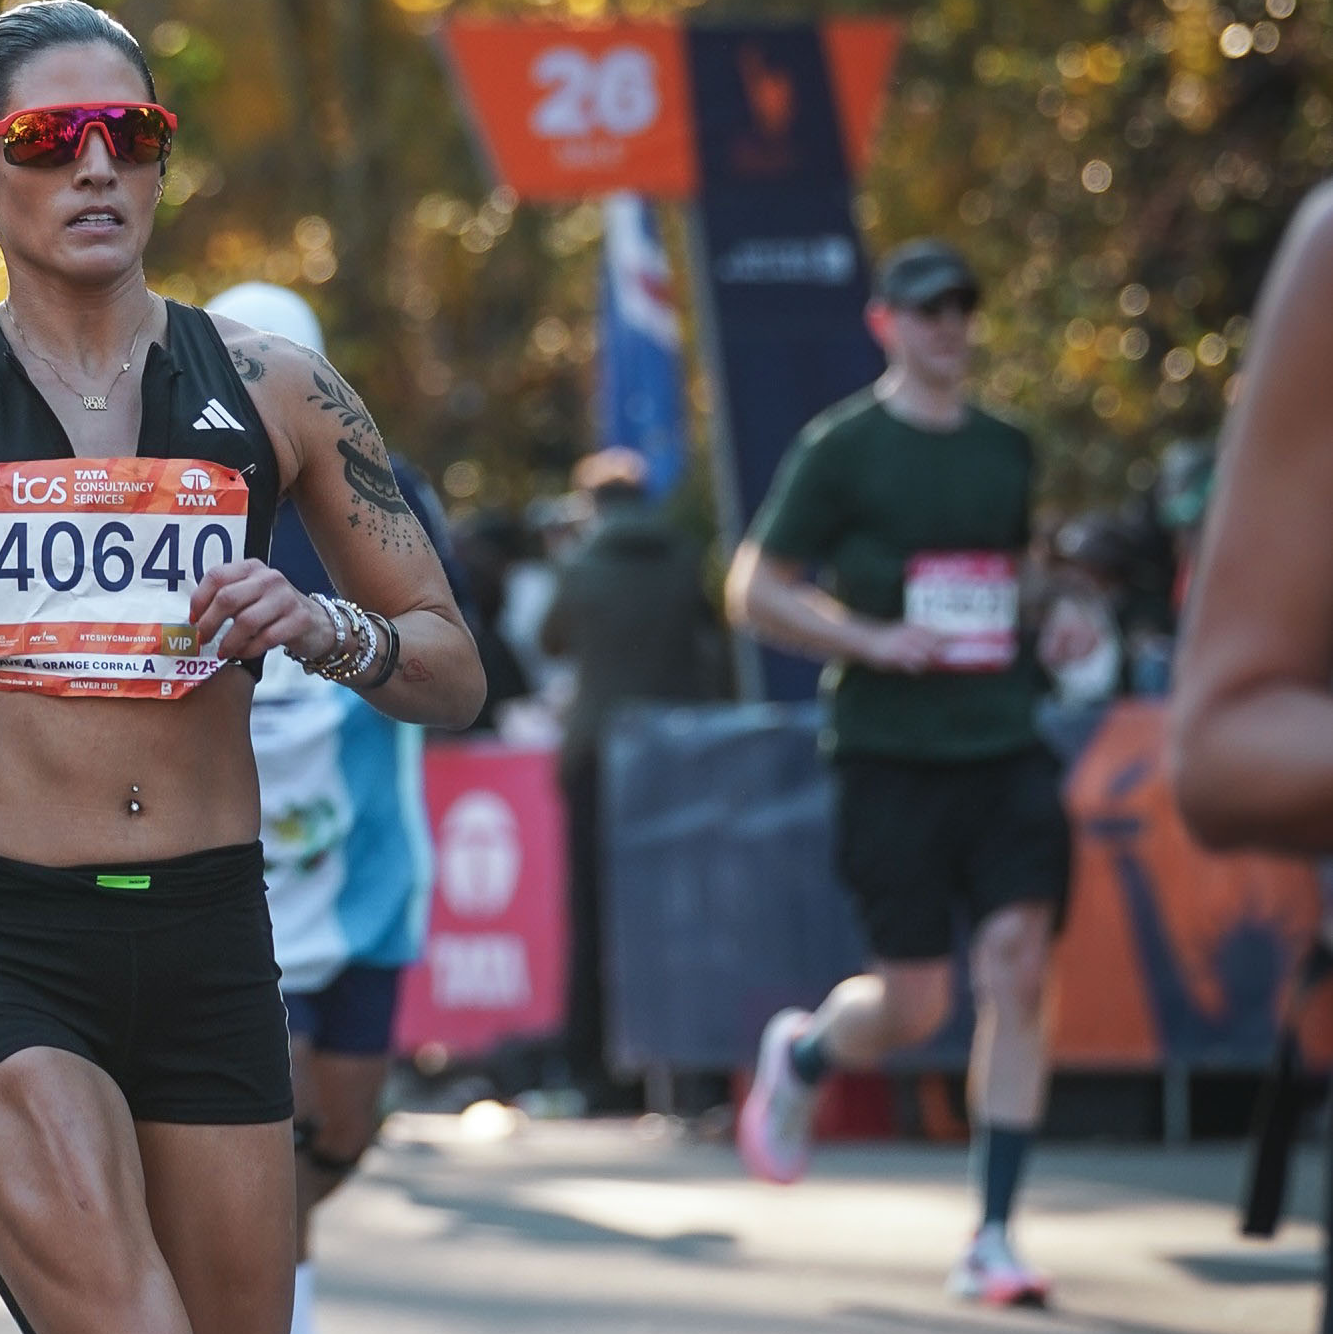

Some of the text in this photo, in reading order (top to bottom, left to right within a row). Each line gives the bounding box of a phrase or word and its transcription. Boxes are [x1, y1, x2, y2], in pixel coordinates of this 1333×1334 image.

[529, 43, 659, 139] 26
[83, 396, 106, 404] NEW
[74, 470, 109, 480] TATA
[12, 471, 67, 505] tcs
[73, 481, 155, 493] CONSULTANCY
[73, 493, 125, 505] SERVICES
[175, 493, 217, 507] TATA
[79, 633, 157, 643] #TCSNYCMarathon
[167, 636, 193, 651] VIP
[42, 660, 90, 670] ORANGE
[92, 661, 139, 672] CORRAL
[142, 658, 156, 674] A
[175, 659, 220, 676] 2025
[70, 681, 118, 691] SILVER BUS
